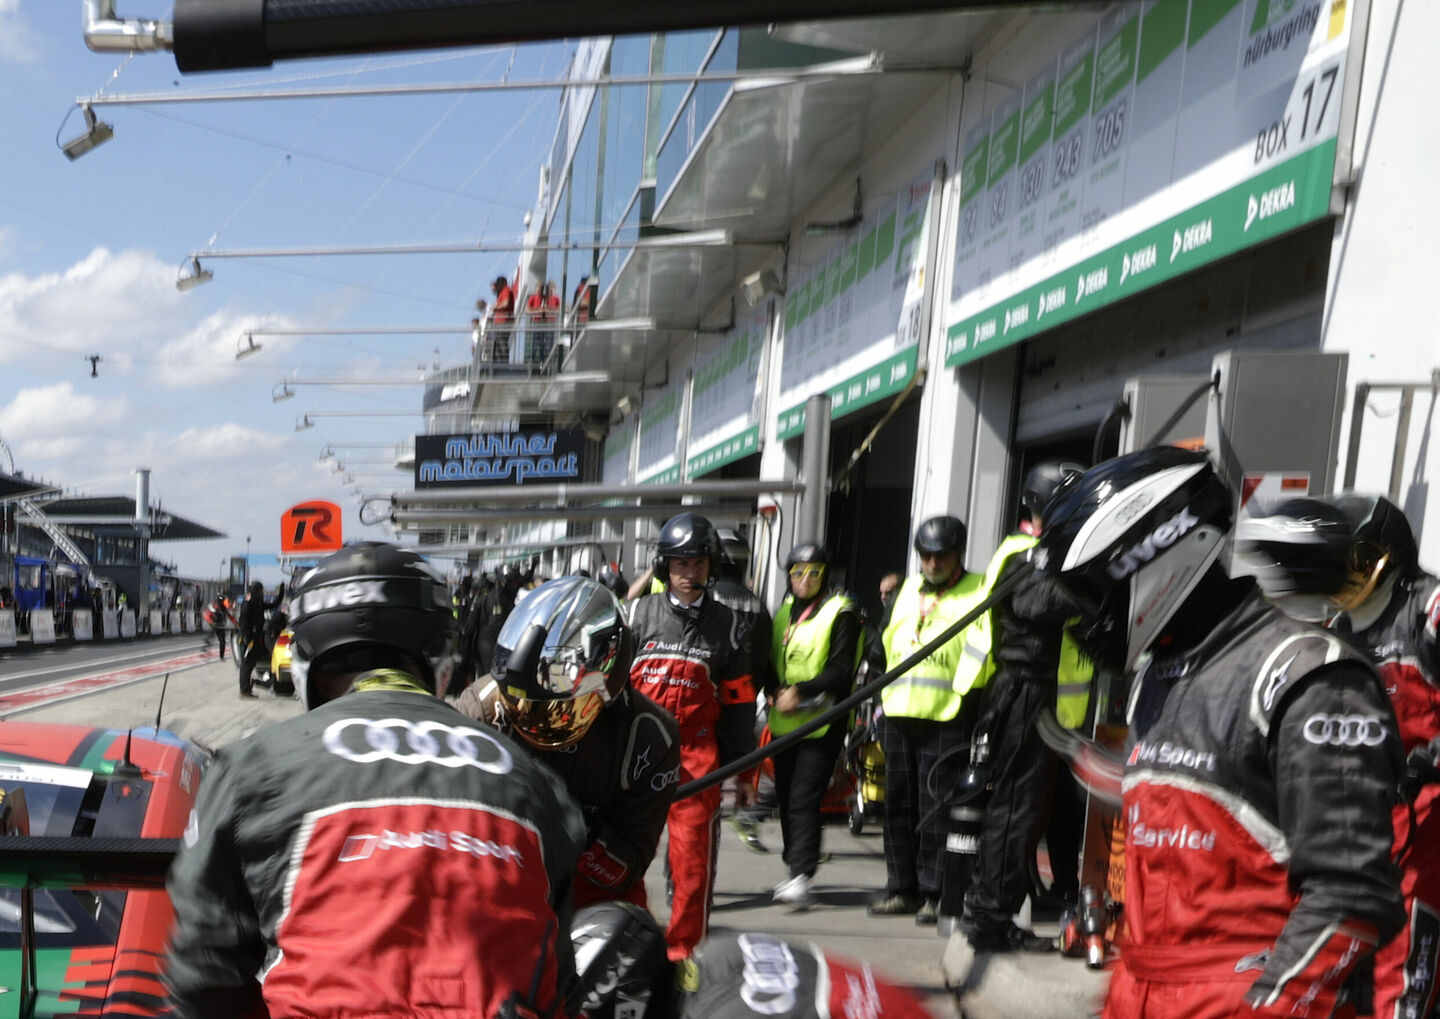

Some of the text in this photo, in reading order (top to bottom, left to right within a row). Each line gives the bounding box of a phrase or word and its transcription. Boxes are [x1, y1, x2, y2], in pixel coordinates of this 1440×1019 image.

[1244, 4, 1320, 69] nürburgring
[1254, 64, 1339, 165] BOX 17
[1260, 179, 1295, 220] DEKRA
[1183, 216, 1212, 250] DEKRA
[1131, 244, 1156, 276] DEKRA
[1085, 266, 1108, 296] DEKRA
[445, 432, 557, 459] mühlner
[420, 452, 578, 485] motorsport
[1108, 506, 1200, 580] uvex
[657, 642, 682, 651] Audi
[642, 665, 667, 675] Audi
[642, 674, 701, 689] Top Service
[1158, 741, 1216, 772] Sport
